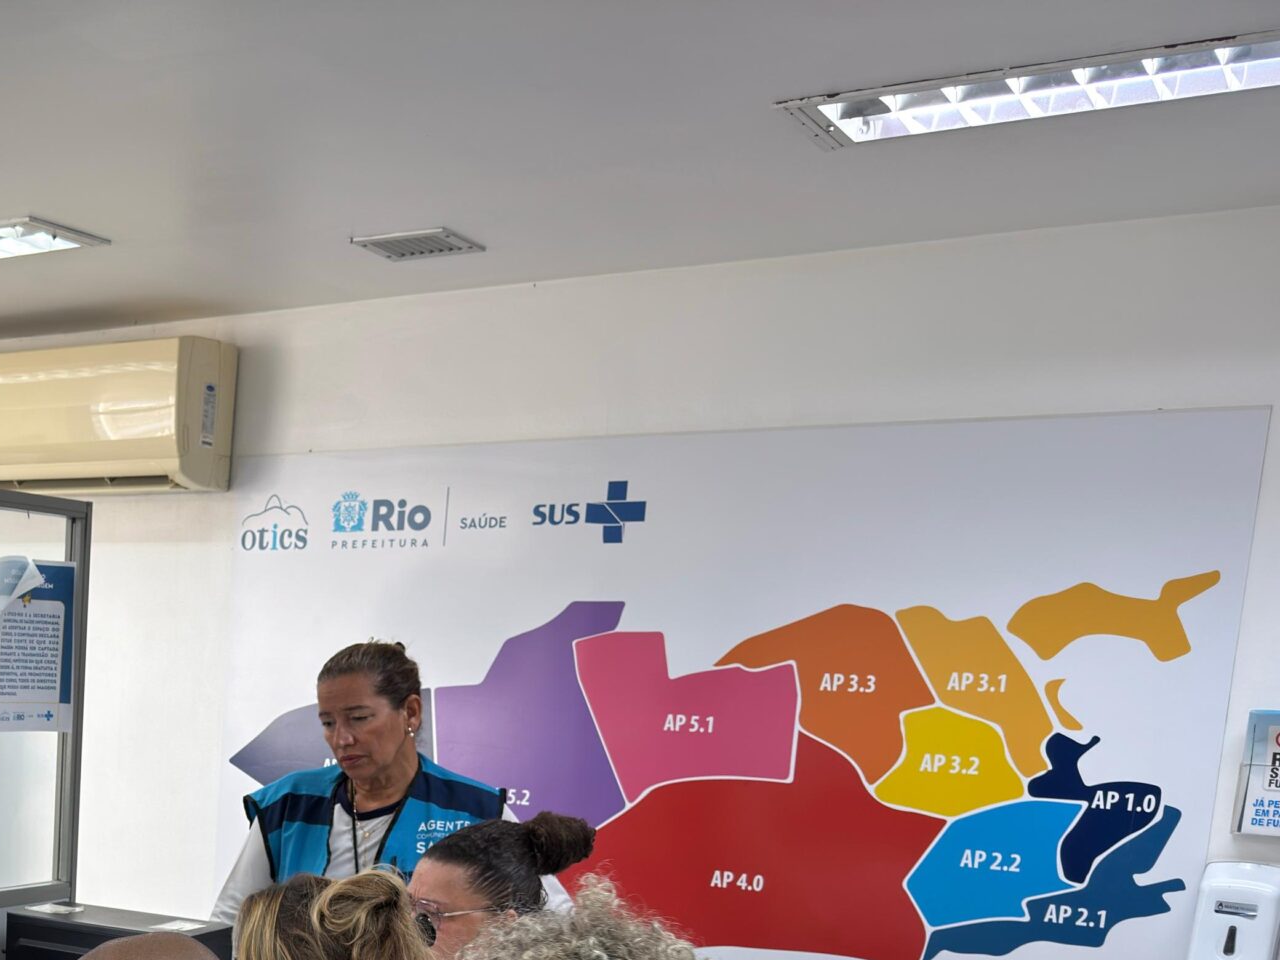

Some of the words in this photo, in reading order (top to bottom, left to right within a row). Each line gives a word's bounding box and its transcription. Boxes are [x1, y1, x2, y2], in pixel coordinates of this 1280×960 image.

[371, 499, 431, 532] Rio
[459, 513, 507, 530] SAÚDE
[532, 503, 580, 526] SUS
[241, 520, 308, 551] otics
[331, 538, 429, 549] PREFEITURA
[820, 673, 844, 692] AP
[847, 675, 876, 693] 3.3
[947, 672, 974, 692] AP
[977, 674, 1007, 693] 3.1
[664, 714, 686, 732] AP
[689, 715, 714, 734] 5.1
[920, 753, 946, 773] AP
[949, 755, 980, 776] 3.2
[507, 789, 530, 806] 5.2
[1091, 790, 1120, 810] AP
[1125, 793, 1156, 813] 1.0
[1253, 797, 1264, 807] JÁ
[1251, 818, 1264, 826] DE
[1255, 808, 1269, 817] EM
[960, 849, 987, 869] AP
[990, 852, 1021, 873] 2.2
[710, 870, 733, 889] AP
[736, 873, 764, 892] 4.0
[1043, 904, 1072, 924] AP
[1075, 908, 1107, 929] 2.1
